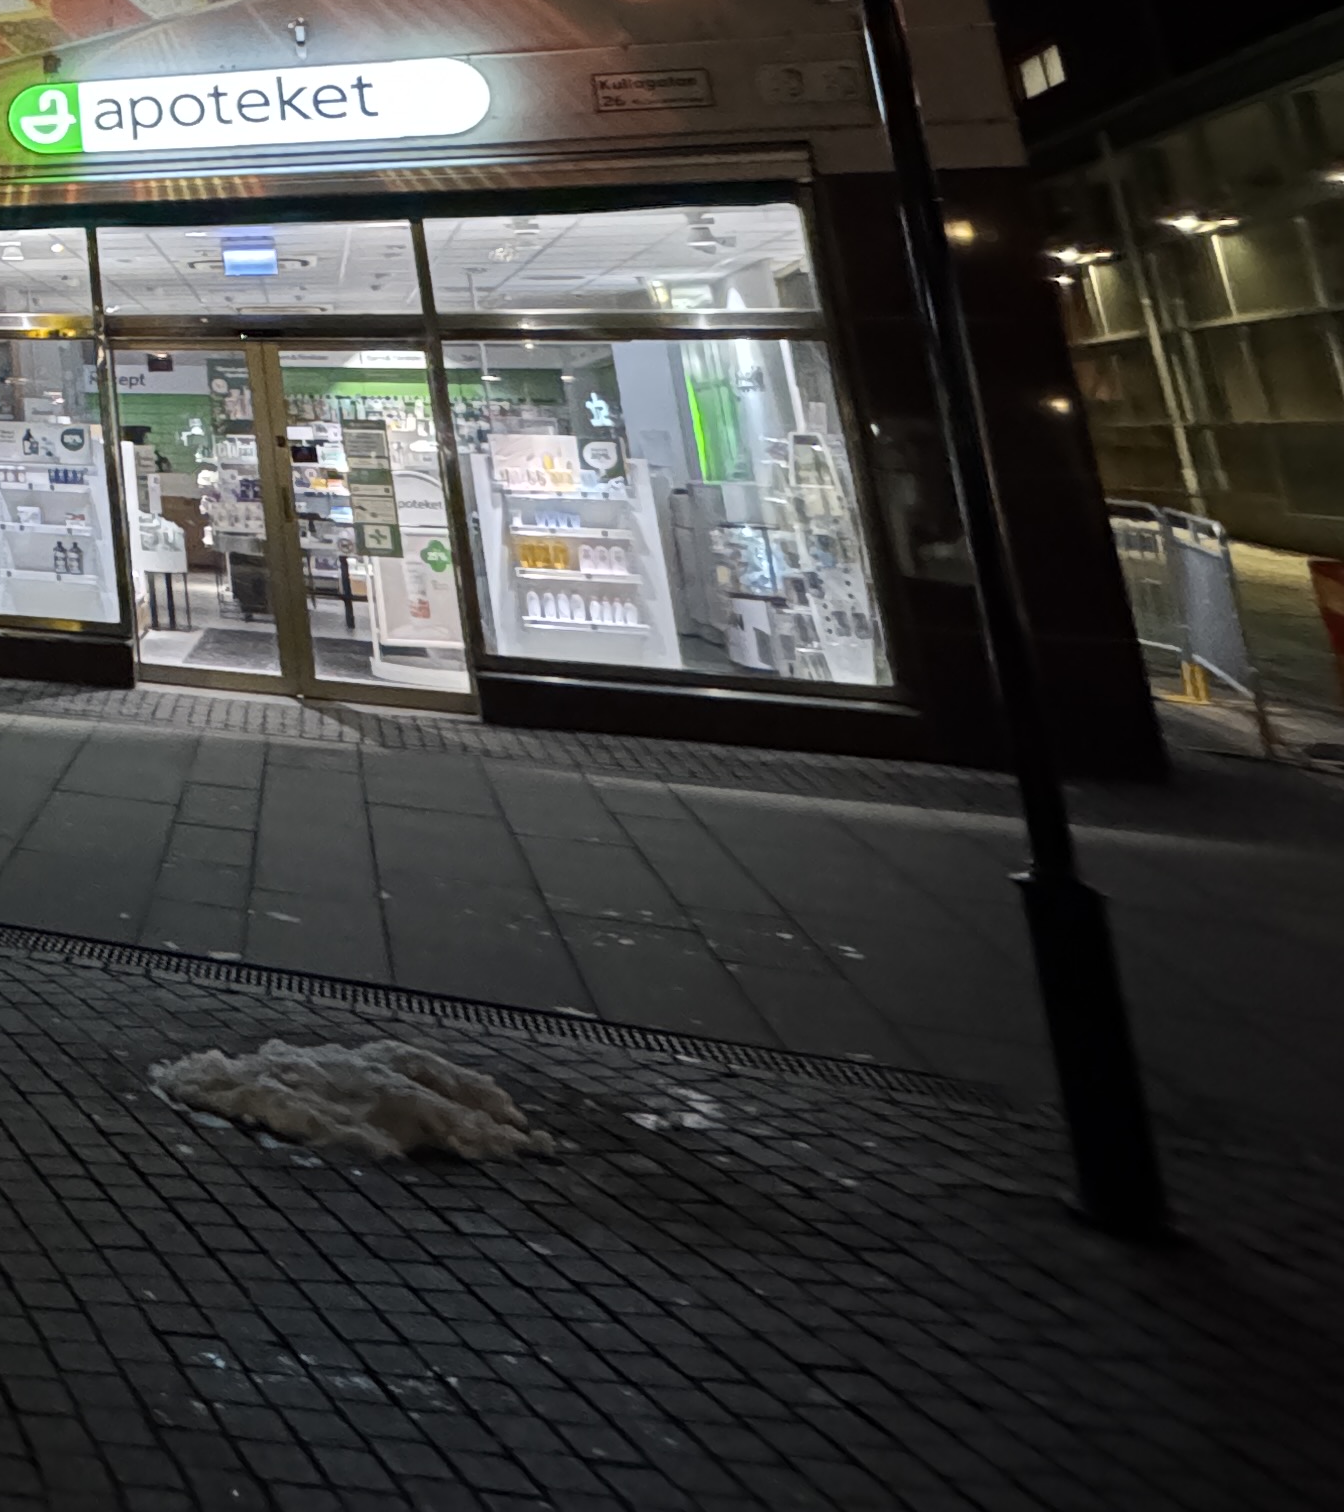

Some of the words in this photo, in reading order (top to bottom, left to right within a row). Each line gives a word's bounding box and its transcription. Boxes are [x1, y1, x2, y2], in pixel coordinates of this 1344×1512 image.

[598, 76, 698, 91] Kullagatan
[93, 75, 379, 140] apoteket
[398, 497, 443, 510] poteket
